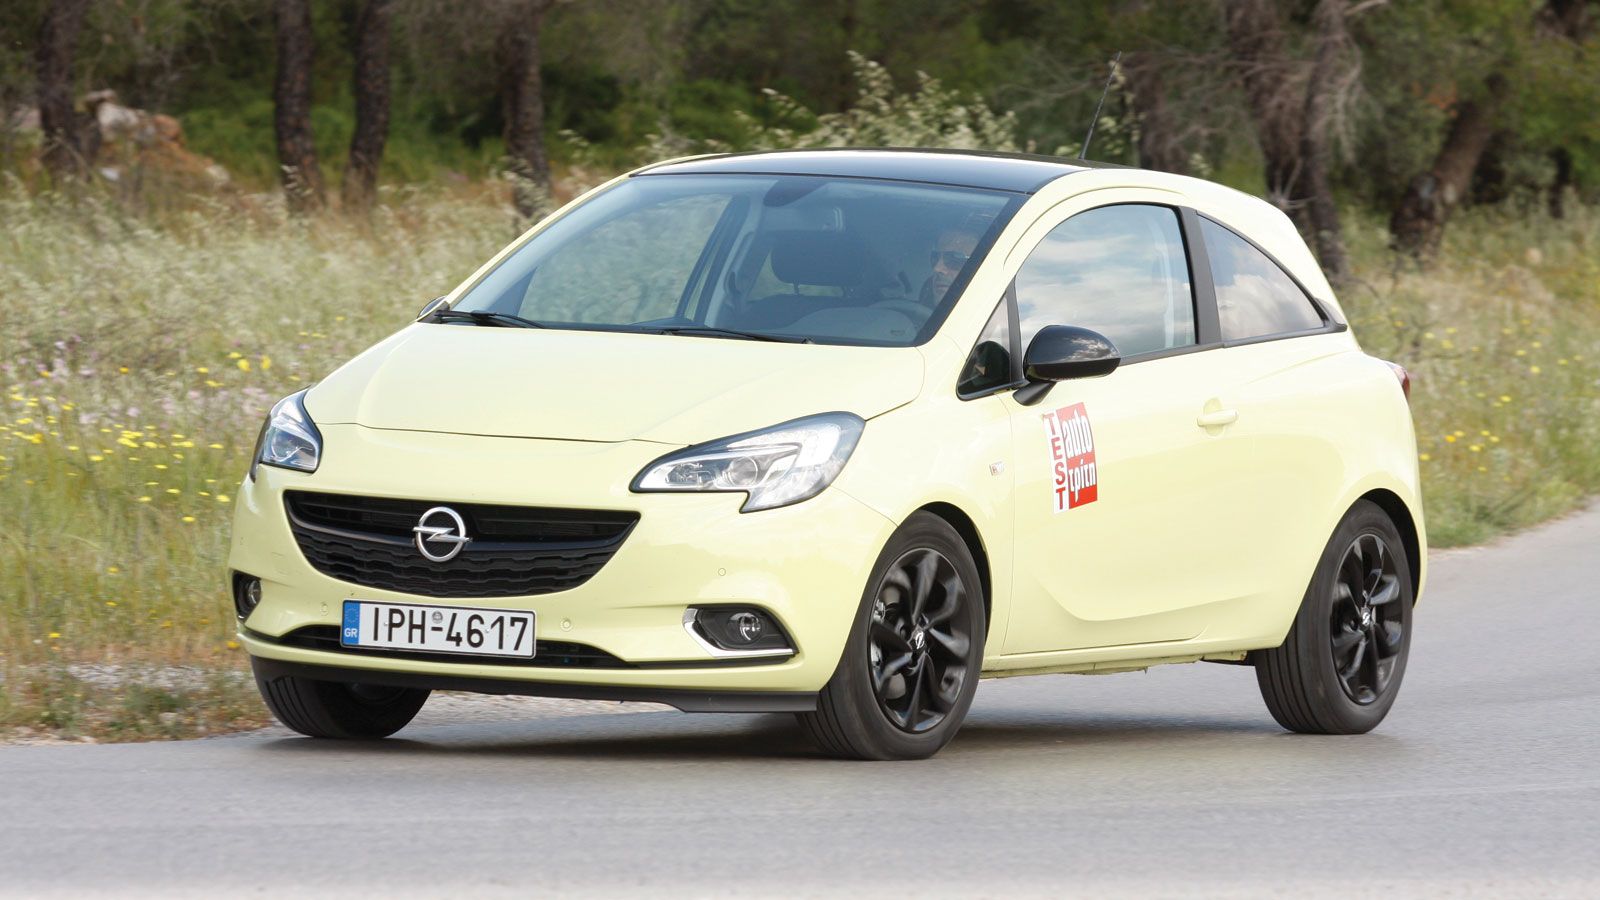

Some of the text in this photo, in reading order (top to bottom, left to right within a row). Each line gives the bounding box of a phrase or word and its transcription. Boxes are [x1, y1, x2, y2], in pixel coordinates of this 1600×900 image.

[1062, 409, 1093, 458] auto
[1042, 412, 1066, 510] TEST
[344, 627, 358, 638] GR
[373, 607, 529, 651] IPH-4617
